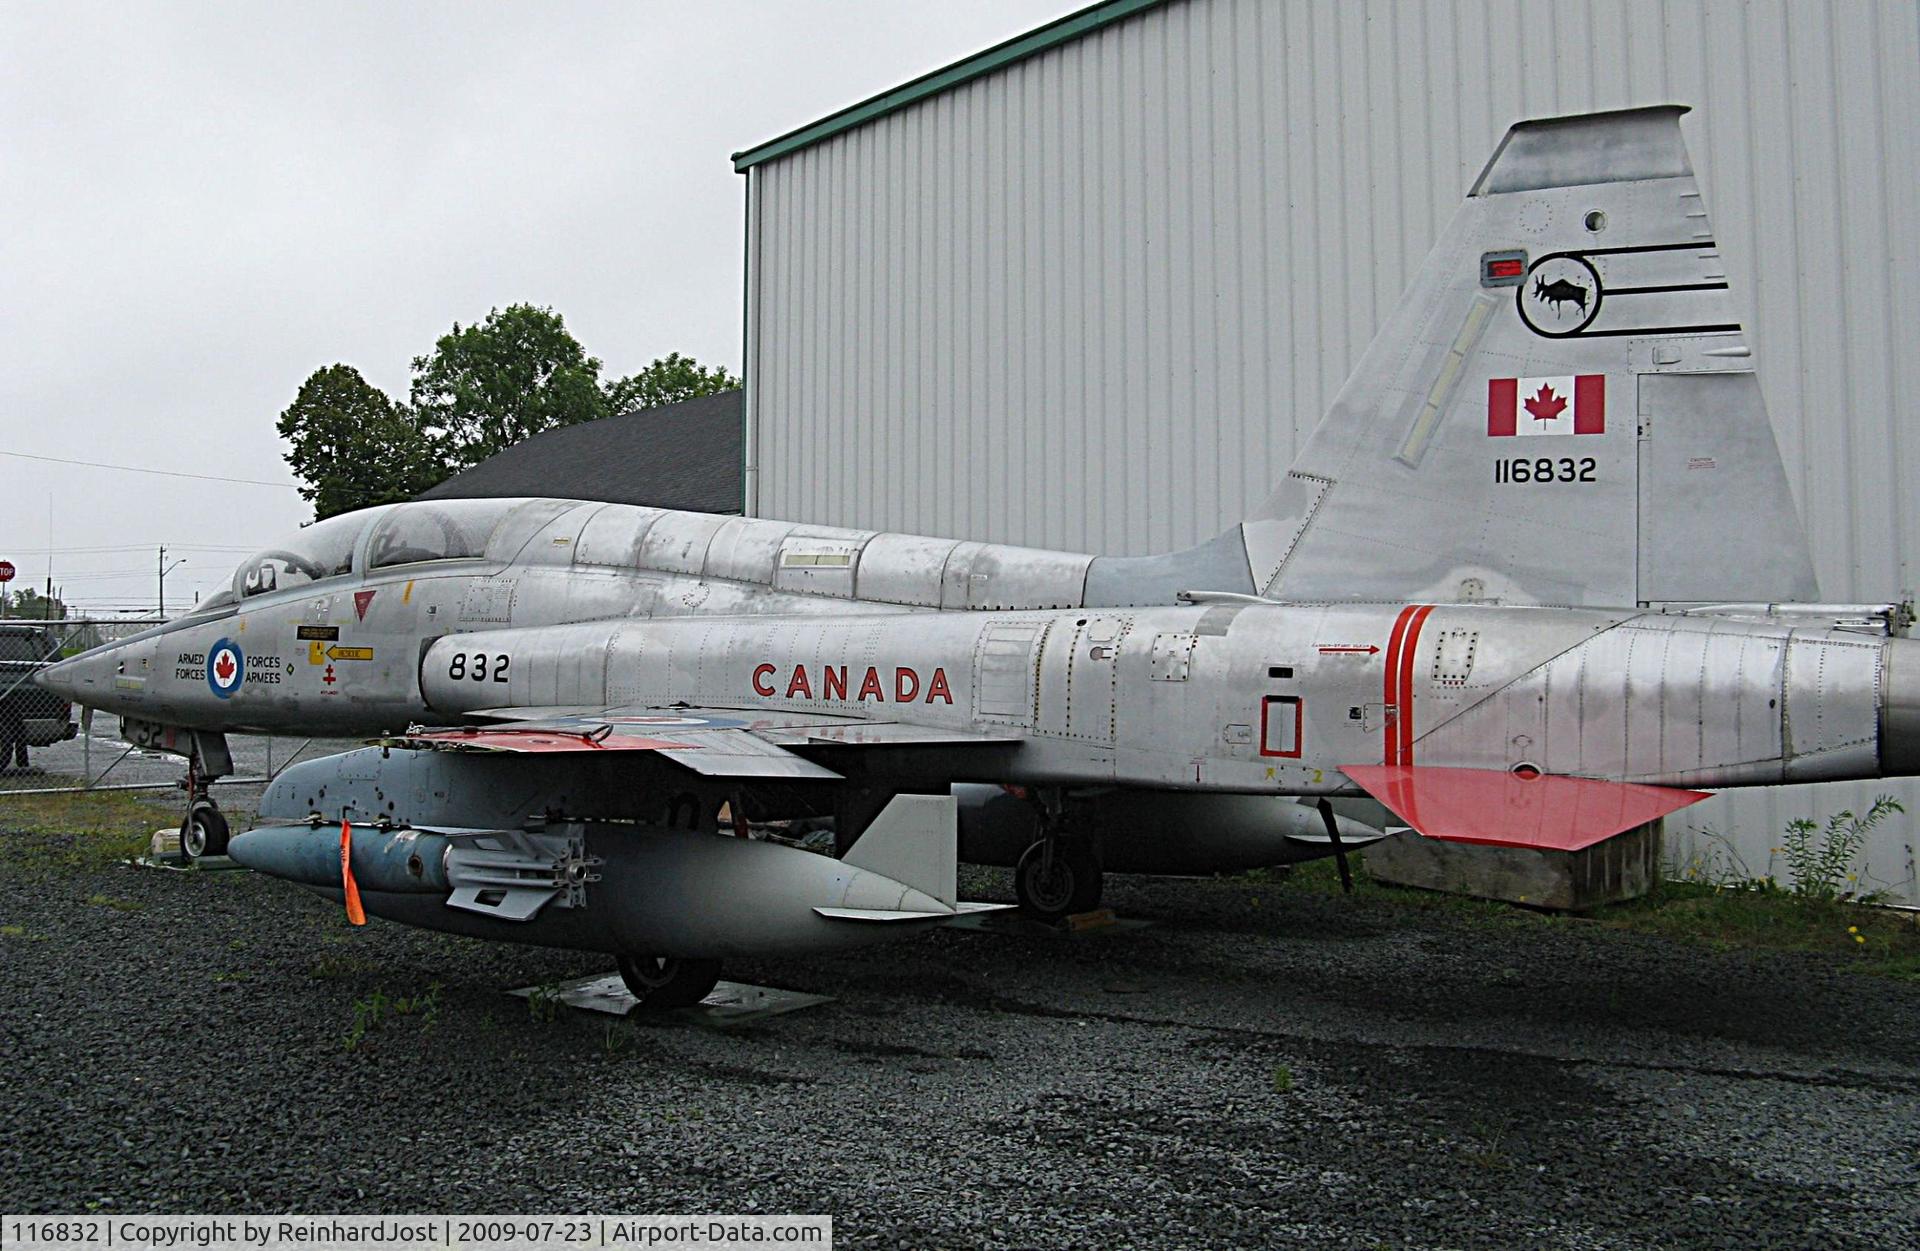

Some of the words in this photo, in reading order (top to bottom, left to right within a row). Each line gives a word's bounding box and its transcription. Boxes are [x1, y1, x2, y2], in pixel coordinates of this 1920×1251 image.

[1495, 457, 1597, 484] 116832
[0, 567, 13, 577] TOP
[177, 653, 205, 665] ARMED
[246, 656, 281, 668] FORCES
[175, 668, 206, 680] FORCES
[449, 653, 510, 683] 832
[752, 663, 954, 705] CANADA
